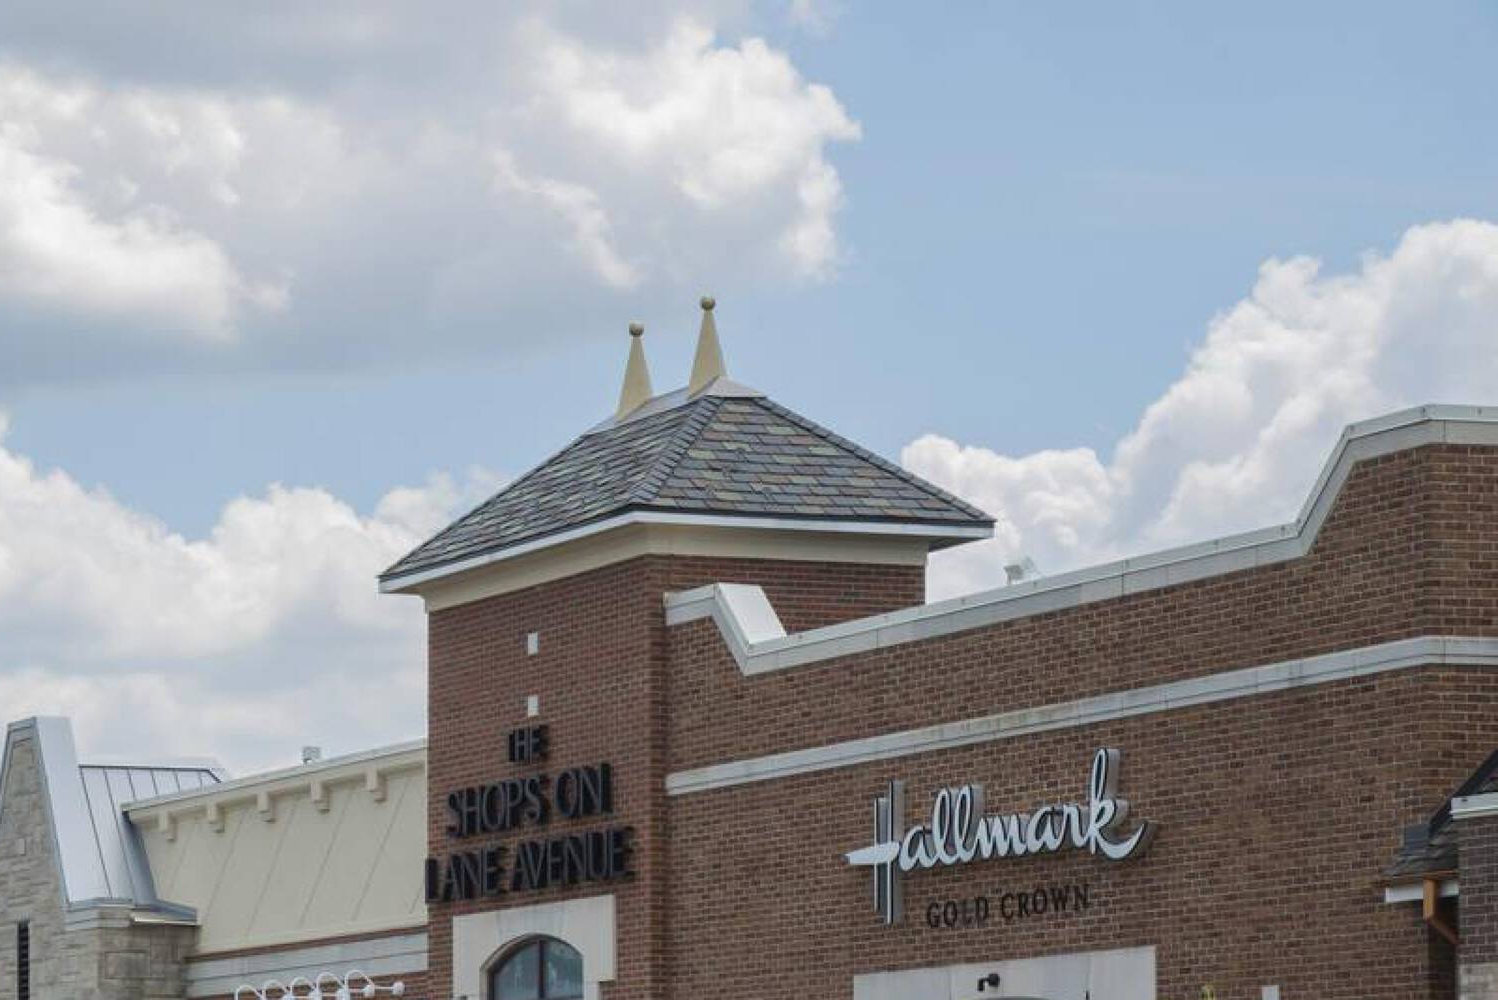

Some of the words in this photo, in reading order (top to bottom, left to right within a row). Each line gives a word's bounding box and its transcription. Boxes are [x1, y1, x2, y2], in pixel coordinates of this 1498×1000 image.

[446, 774, 550, 838] SHOPS
[554, 762, 612, 819] ON
[843, 747, 1154, 926] Hallmark
[425, 846, 508, 904] LANE
[510, 826, 634, 890] AVENUE
[926, 896, 990, 929] GOLD
[1001, 884, 1093, 920] CROWN
